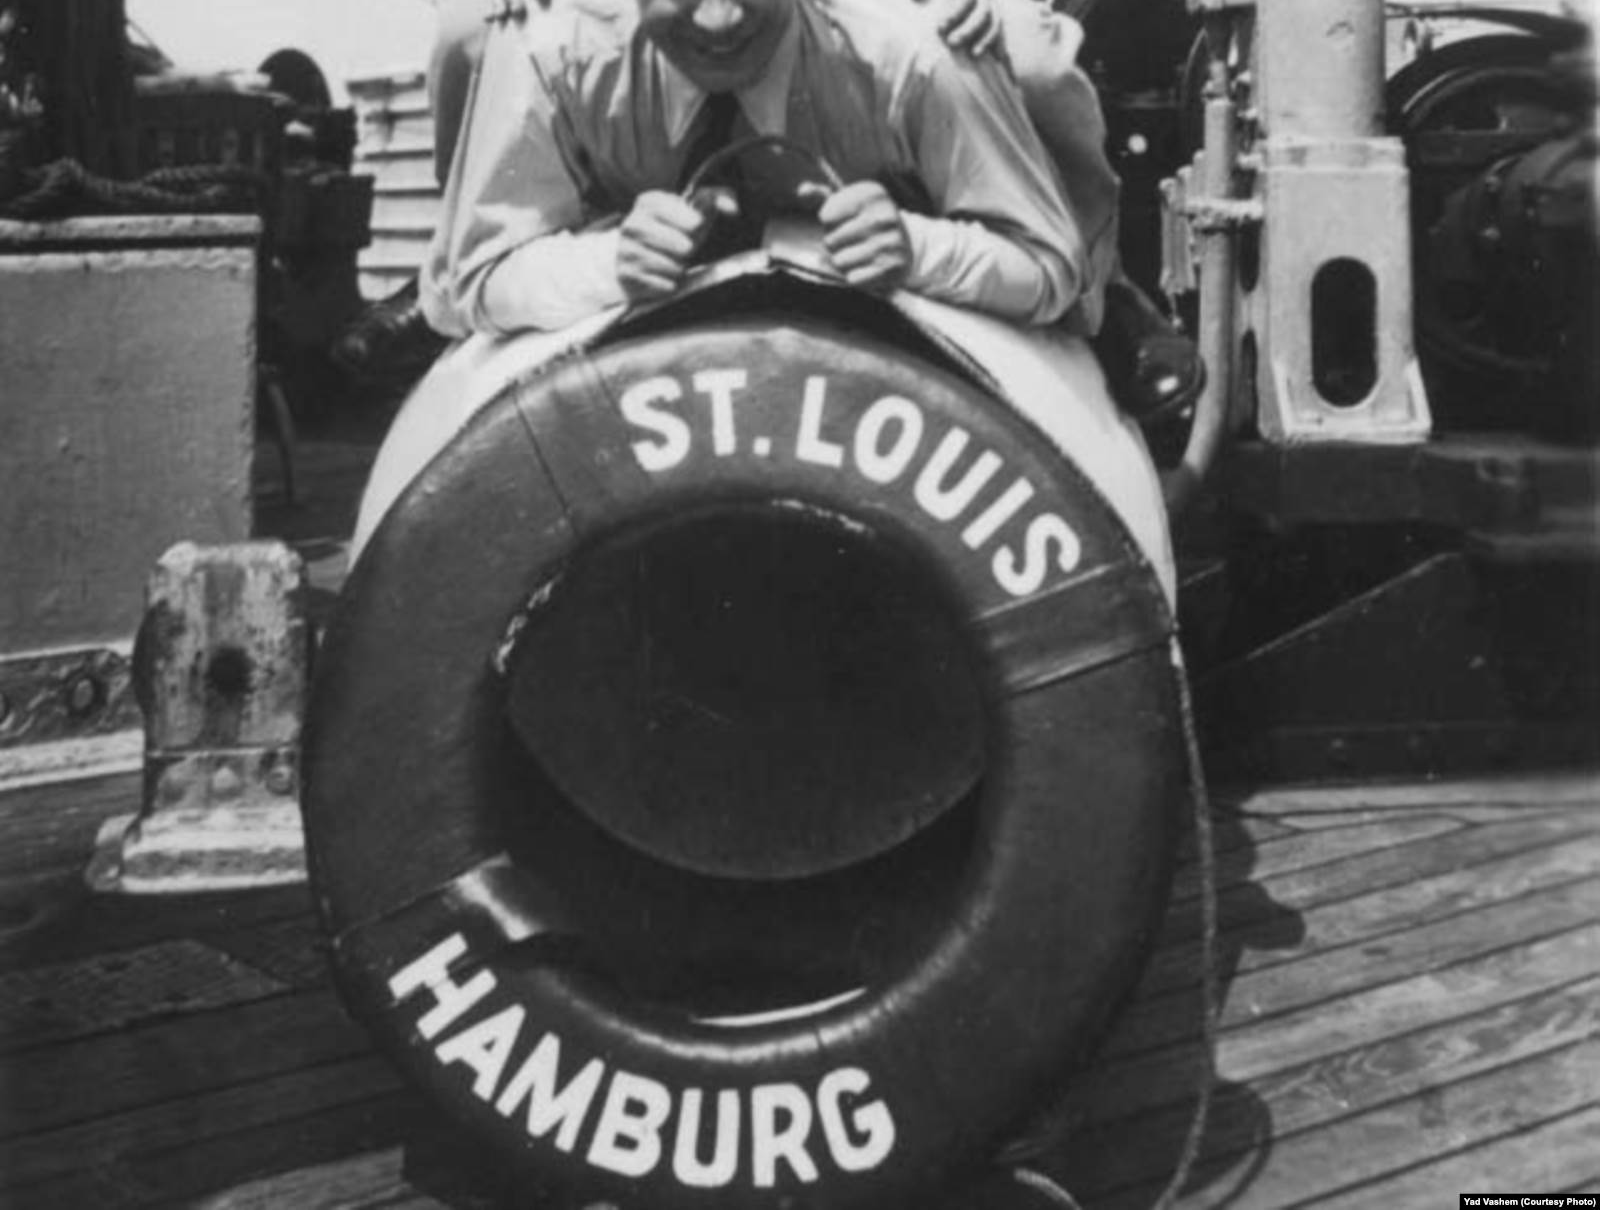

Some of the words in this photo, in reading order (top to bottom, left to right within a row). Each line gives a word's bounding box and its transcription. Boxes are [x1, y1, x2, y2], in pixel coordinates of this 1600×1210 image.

[620, 369, 771, 471] ST.
[796, 375, 1081, 596] LOUIS
[388, 932, 895, 1188] HAMBURG
